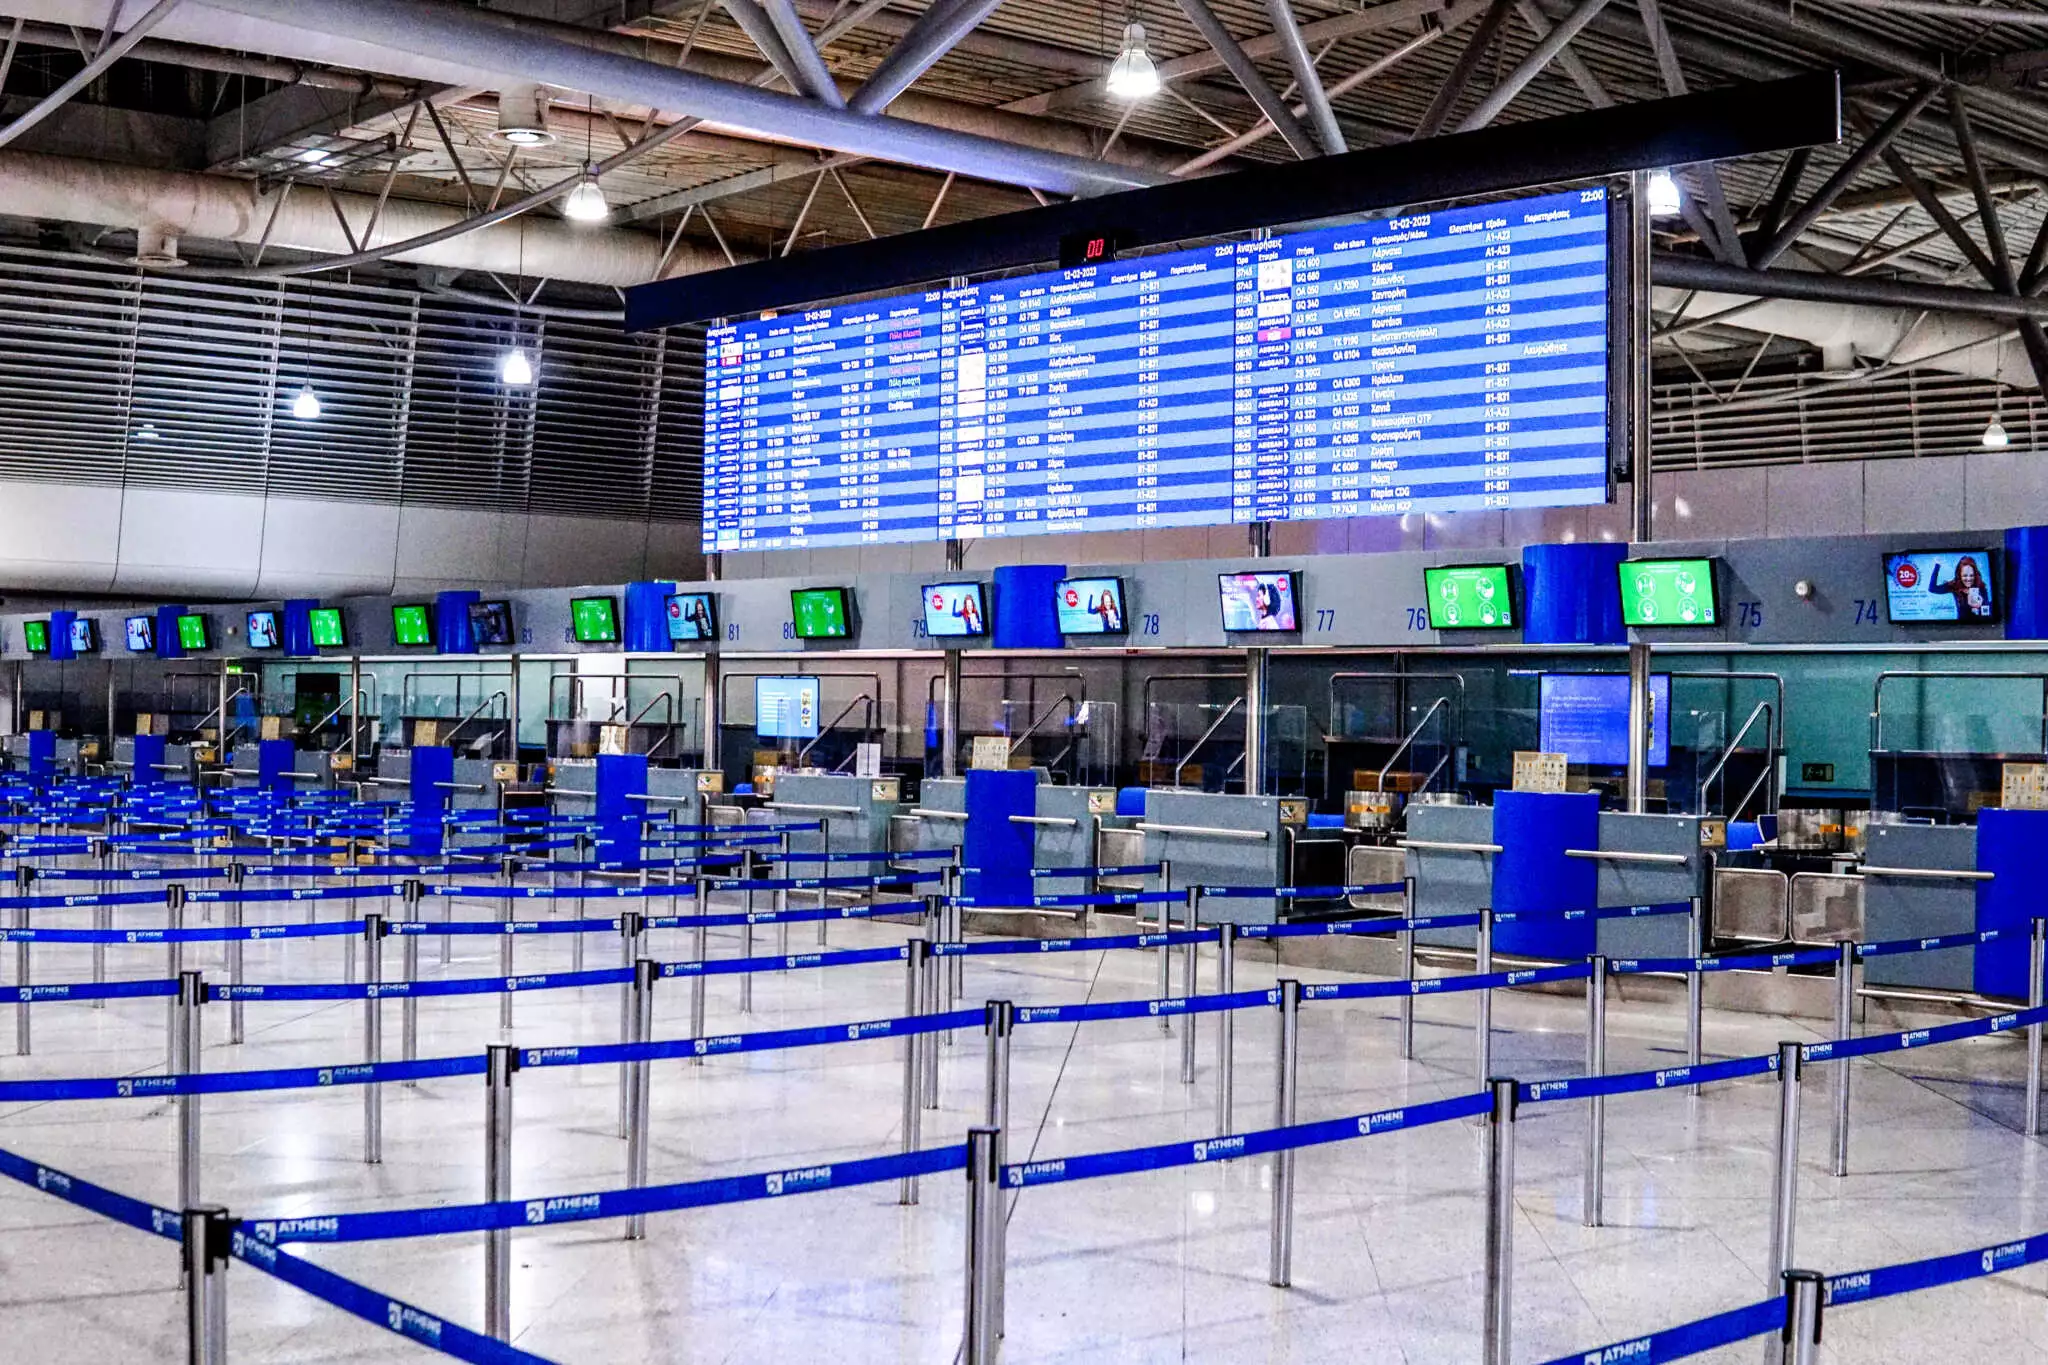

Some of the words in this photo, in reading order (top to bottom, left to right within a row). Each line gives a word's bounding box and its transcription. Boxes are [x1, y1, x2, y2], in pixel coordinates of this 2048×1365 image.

[1580, 190, 1604, 203] 22:00
[1390, 216, 1430, 230] 12-02-2023
[1486, 230, 1510, 242] A1-A23
[1087, 239, 1104, 258] 00
[1215, 246, 1233, 256] 22:00
[1486, 245, 1510, 256] A1-A23
[1486, 260, 1510, 271] B1-B31
[1064, 266, 1096, 280] 12-02-2023
[1486, 274, 1510, 286] B1-B31
[1486, 289, 1510, 300] A1-A23
[1486, 304, 1510, 315] A1-A23
[1486, 318, 1510, 330] A1-A23
[1486, 333, 1510, 345] B1-B31
[1485, 362, 1510, 374] B1-B31
[1485, 377, 1510, 388] B1-B31
[1485, 392, 1510, 403] B1-B31
[1485, 406, 1510, 418] A1-A23
[1485, 422, 1510, 433] B1-B31
[1485, 436, 1510, 448] B1-B31
[1485, 451, 1510, 462] B1-B31
[1485, 466, 1510, 477] B1-B31
[1395, 486, 1410, 497] CDG
[1485, 480, 1509, 492] B1-B31
[1485, 496, 1509, 506] B1-B31
[1738, 602, 1762, 627] 75
[1854, 600, 1878, 624] 74
[1143, 614, 1159, 635] 78
[1317, 610, 1335, 632] 77
[1407, 608, 1426, 630] 76
[728, 624, 740, 641] 81
[783, 622, 796, 639] 80
[913, 620, 926, 637] 79
[655, 918, 678, 926] ATHENS
[518, 976, 546, 984] ATHENS
[33, 986, 69, 994] ATHENS
[232, 986, 264, 994] ATHENS
[1159, 1000, 1185, 1008] ATHENS
[1998, 1014, 2016, 1023] ATHENS
[860, 1021, 890, 1031] ATHENS
[708, 1036, 742, 1046] ATHENS
[1909, 1031, 1929, 1039] ATHENS
[542, 1049, 578, 1058] ATHENS
[1810, 1044, 1832, 1053] ATHENS
[335, 1066, 373, 1075] ATHENS
[1666, 1068, 1690, 1077] ATHENS
[135, 1078, 176, 1087] ATHENS
[1541, 1082, 1568, 1090] ATHENS
[1370, 1110, 1403, 1123] ATHENS
[1208, 1136, 1244, 1150] ATHENS
[1024, 1160, 1065, 1174] ATHENS
[785, 1166, 832, 1182] ATHENS
[547, 1195, 599, 1210] ATHENS
[279, 1216, 339, 1233] ATHENS
[1994, 1242, 2026, 1258] ATHENS
[1833, 1274, 1870, 1291] ATHENS
[400, 1307, 442, 1336] ATHENS
[1602, 1338, 1651, 1362] ATHENS
